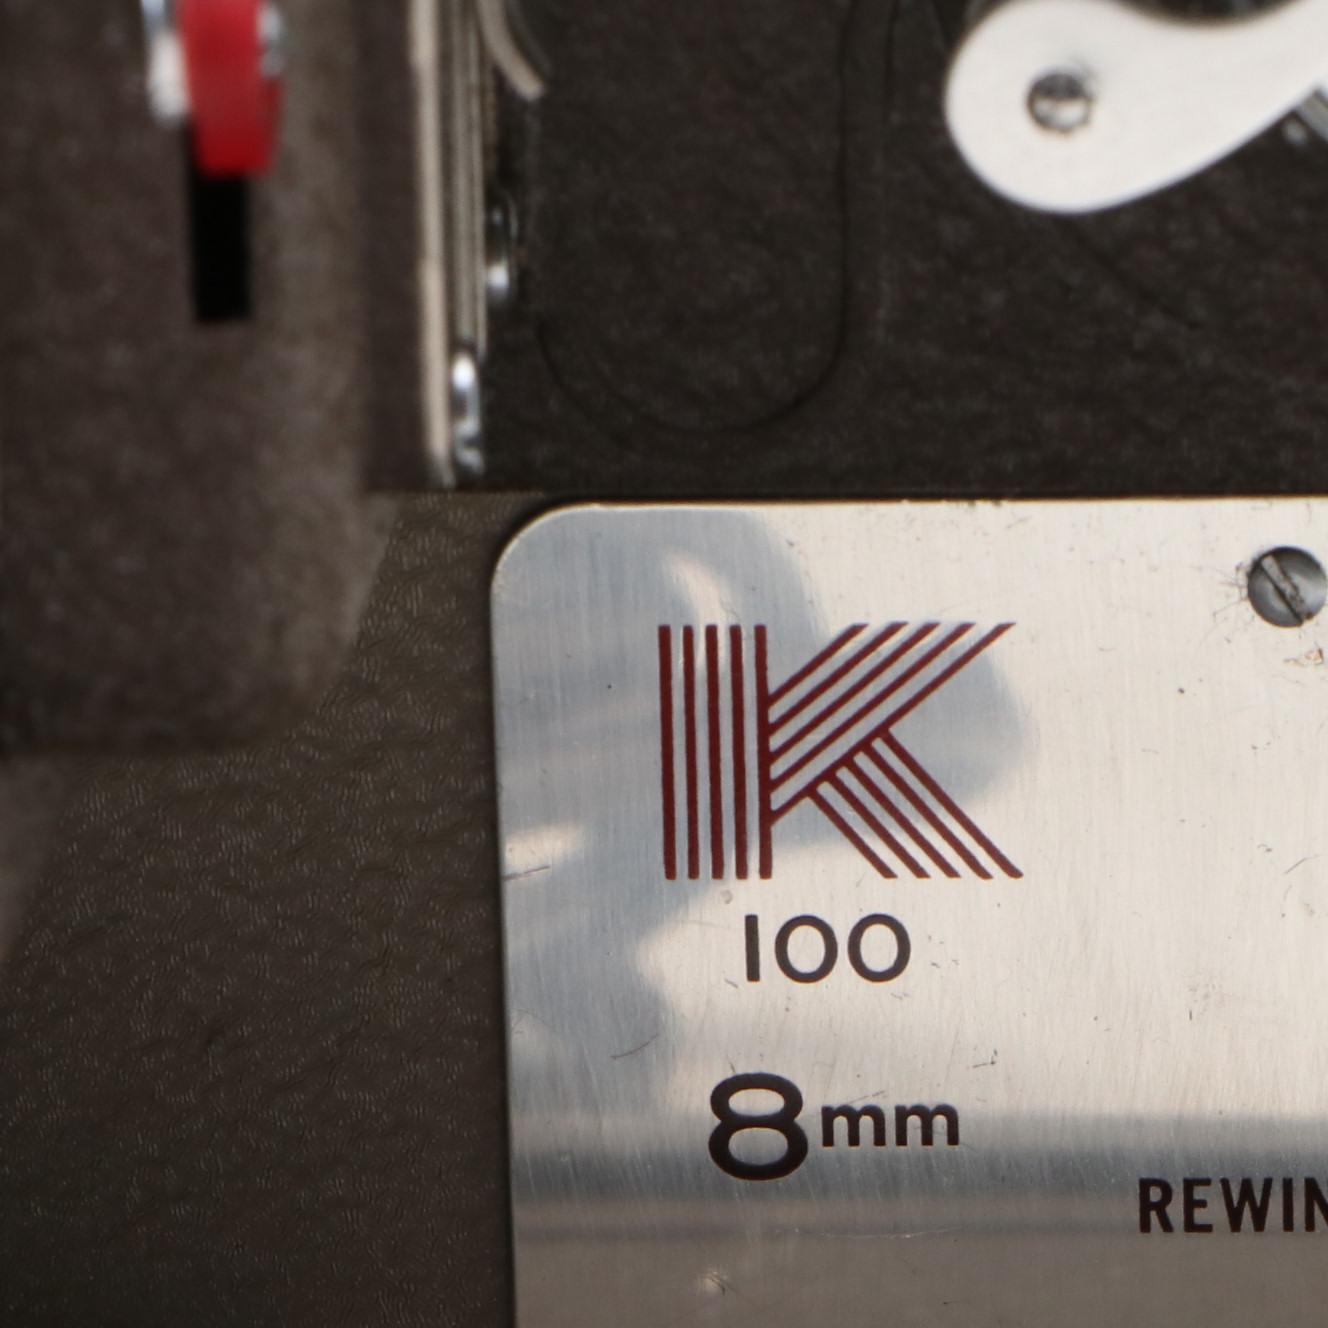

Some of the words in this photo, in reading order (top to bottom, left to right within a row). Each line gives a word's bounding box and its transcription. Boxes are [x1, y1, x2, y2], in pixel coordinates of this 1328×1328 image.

[660, 624, 1022, 880] K
[744, 913, 912, 984] 100
[708, 1071, 960, 1182] 8mm
